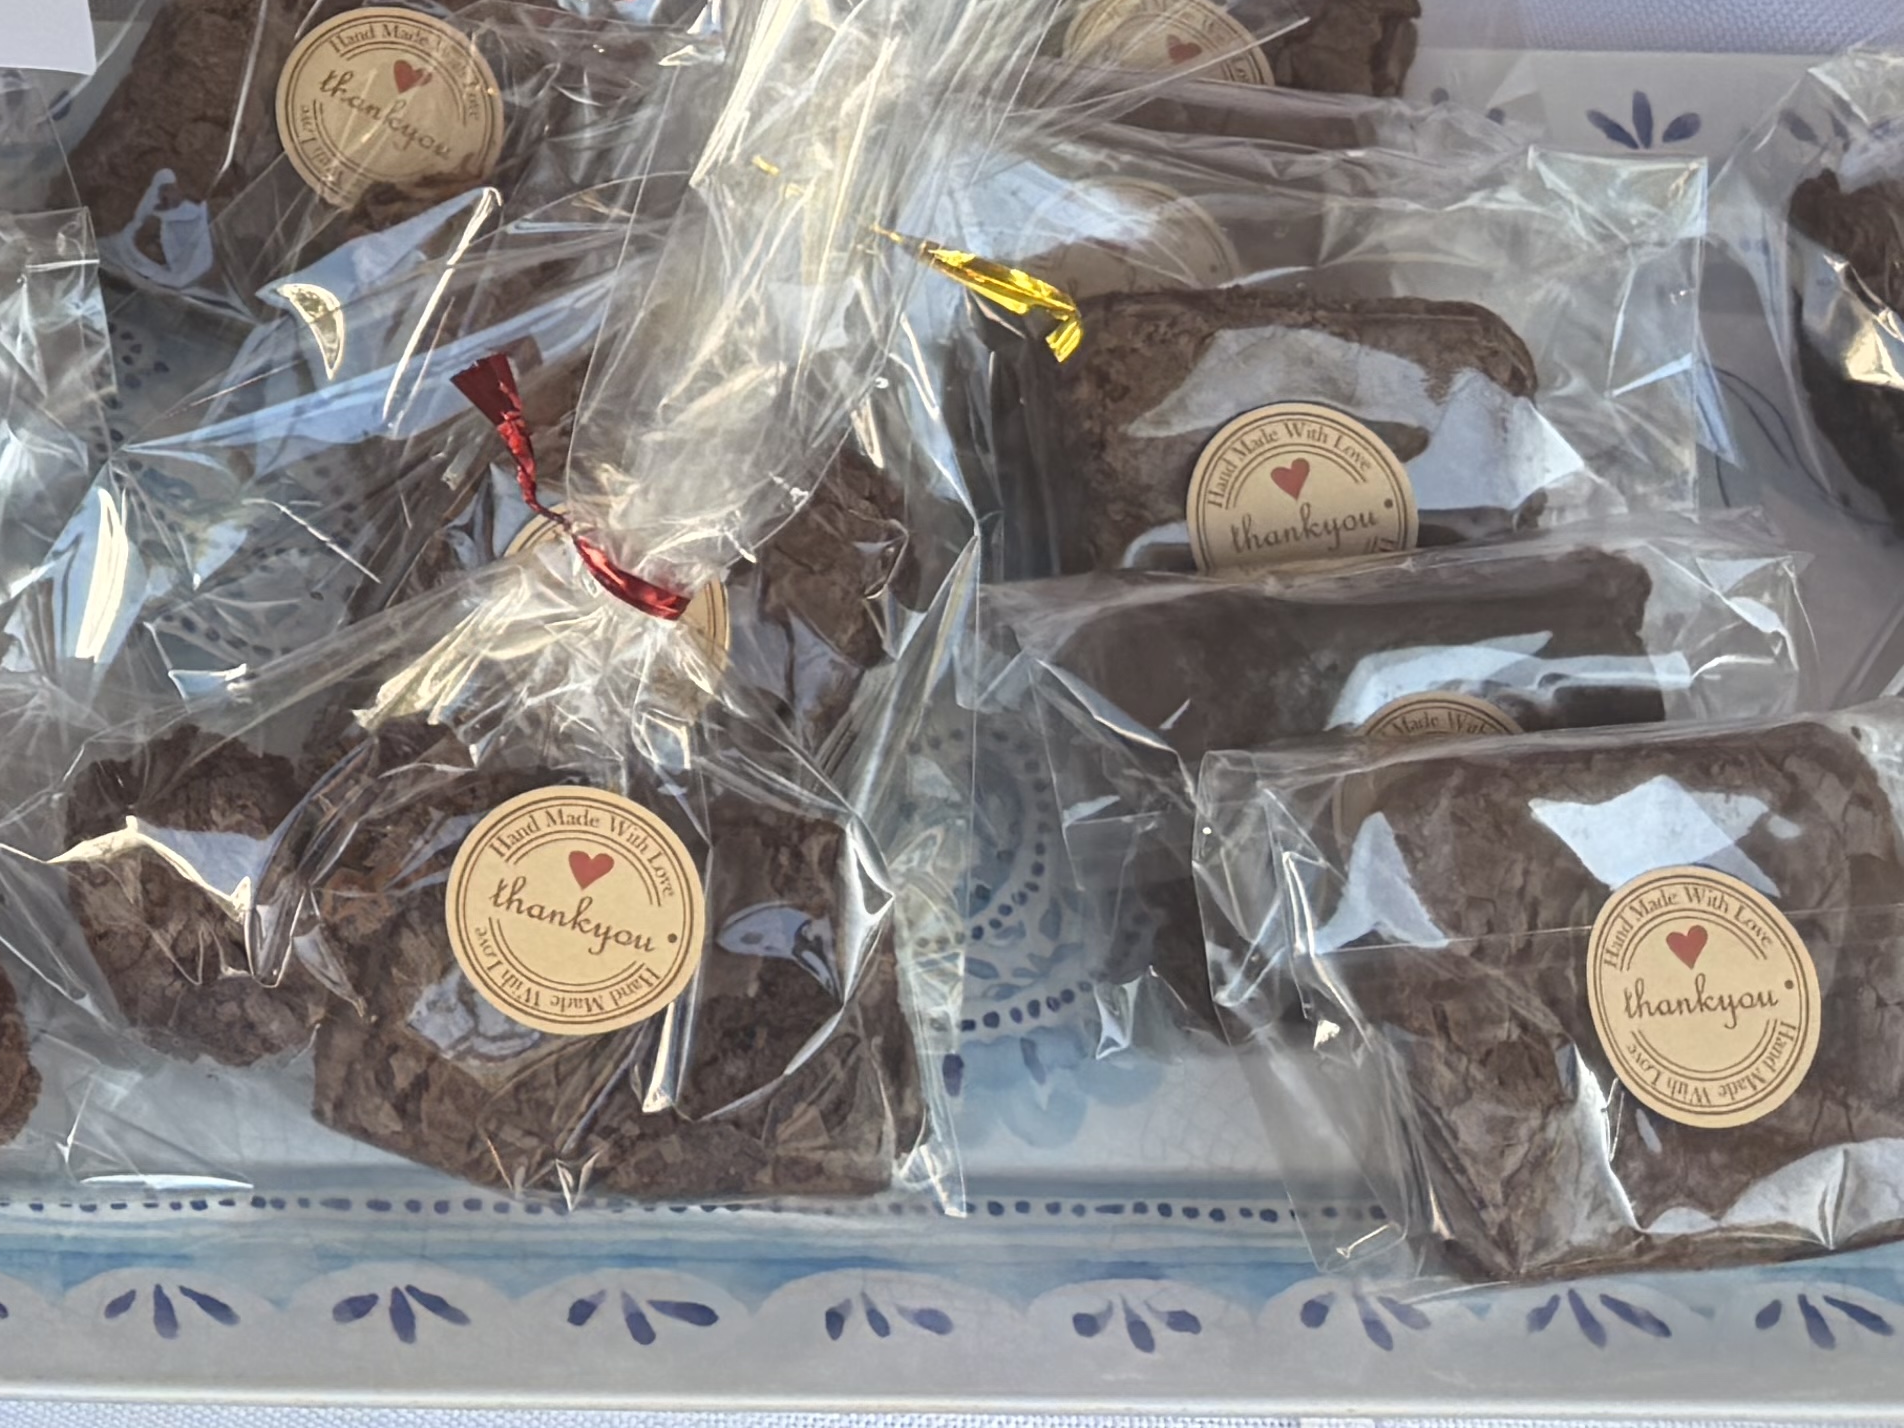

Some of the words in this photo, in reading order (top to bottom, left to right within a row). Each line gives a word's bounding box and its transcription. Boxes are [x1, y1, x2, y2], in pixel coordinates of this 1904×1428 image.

[1206, 461, 1238, 509] Hand
[1235, 427, 1280, 462] Made
[1283, 421, 1329, 444] With
[1332, 436, 1372, 472] Love
[1230, 502, 1379, 555] thankyou
[488, 815, 541, 858] Hand
[545, 807, 601, 829] Made
[608, 815, 651, 856] With
[646, 851, 675, 897] Love
[488, 875, 657, 956] thankyou
[1603, 913, 1633, 970] Hand
[1629, 889, 1679, 919] Made
[1683, 885, 1730, 914] With
[1734, 905, 1773, 946] Love
[1623, 972, 1780, 1030] thankyou
